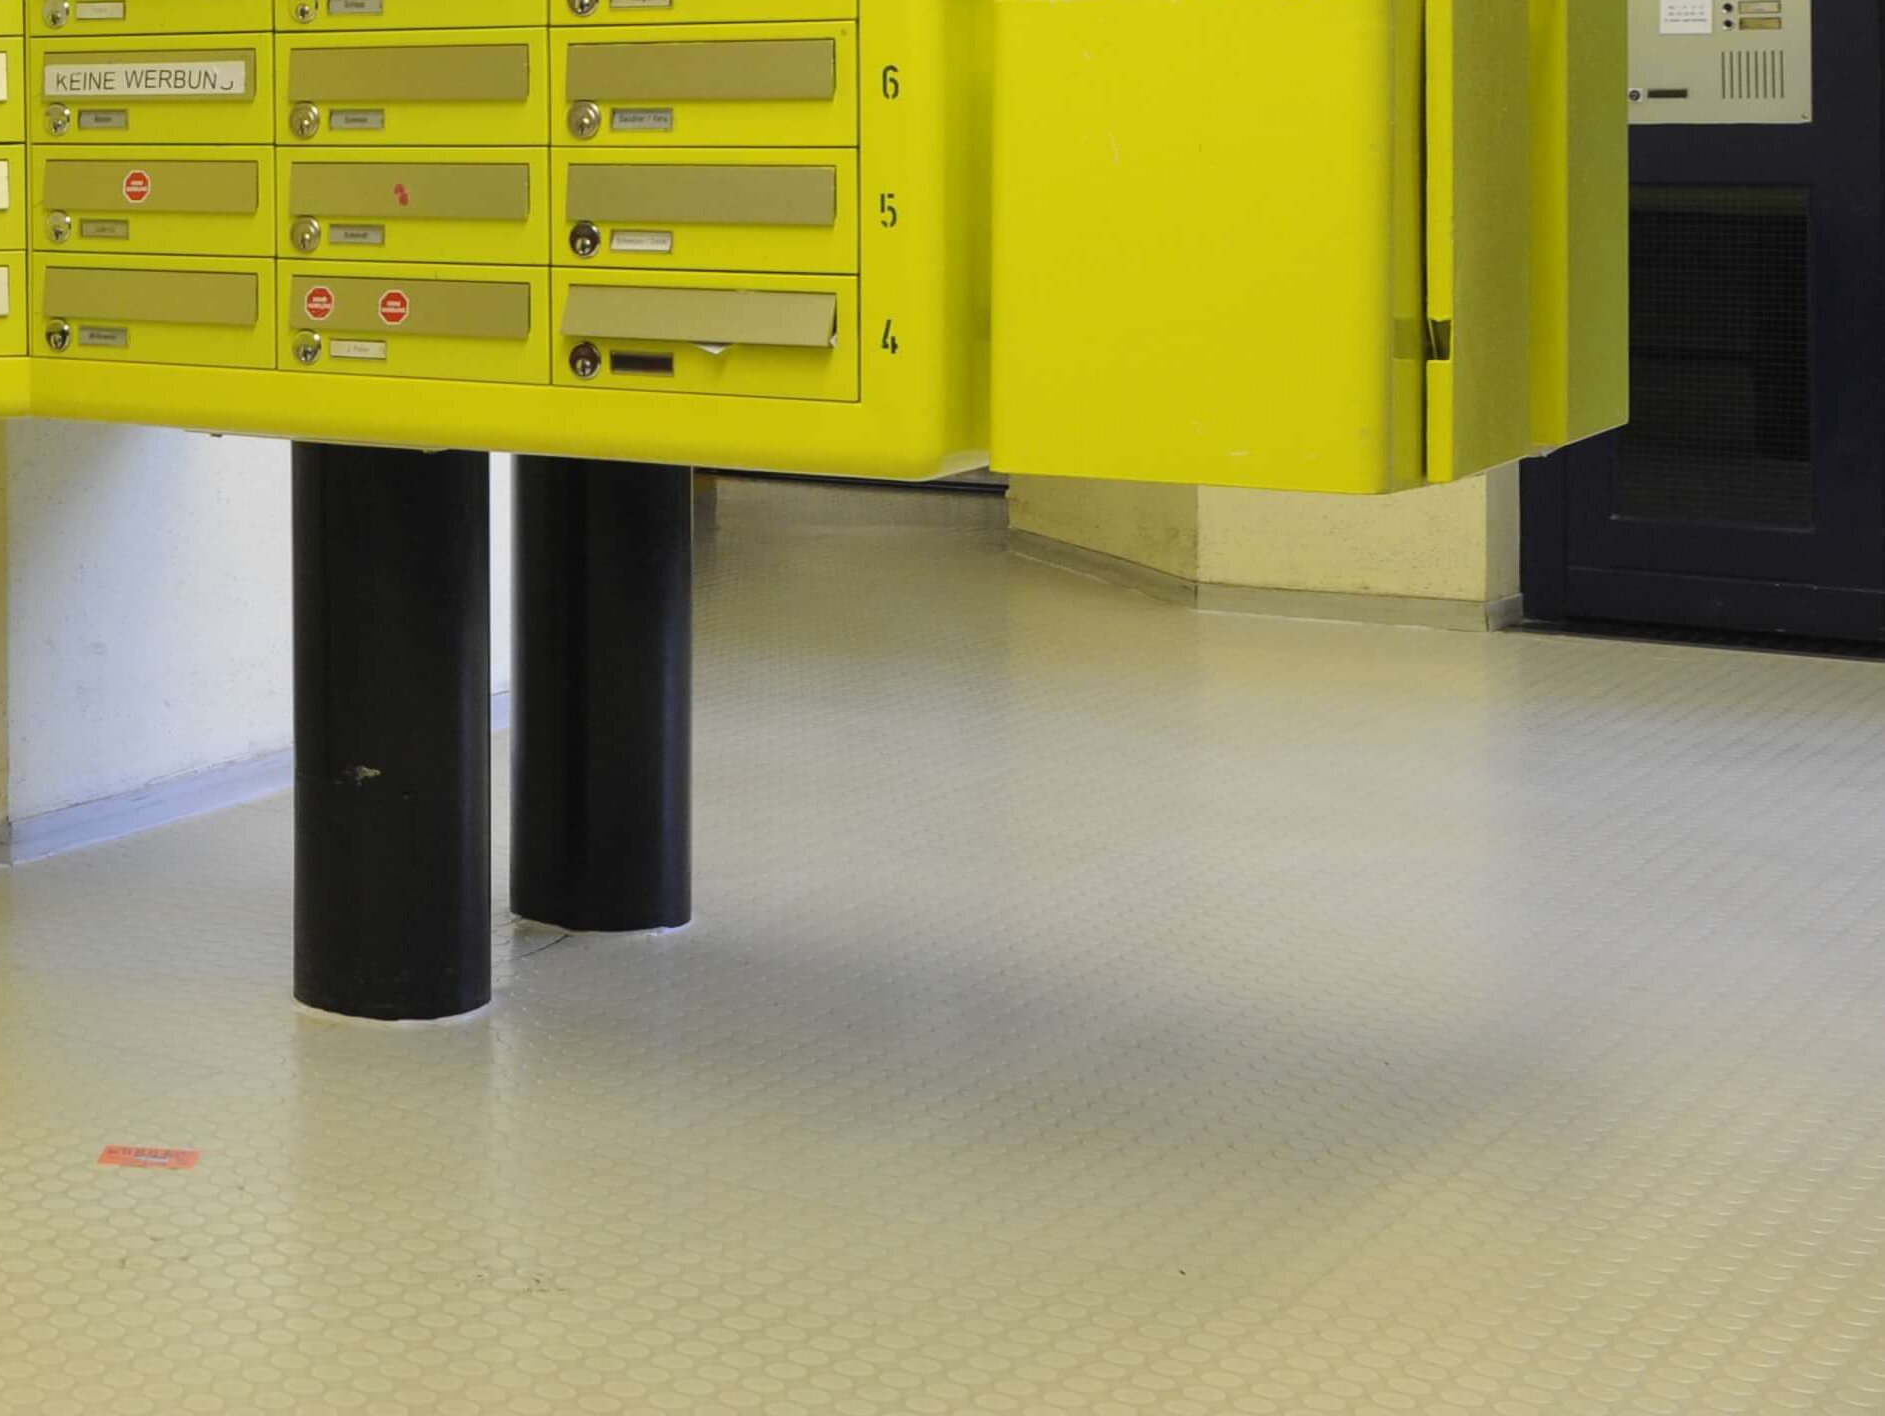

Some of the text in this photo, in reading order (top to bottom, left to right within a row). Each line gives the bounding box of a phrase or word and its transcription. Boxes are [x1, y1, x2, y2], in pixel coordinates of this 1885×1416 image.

[55, 70, 116, 91] KEINE
[882, 64, 899, 100] 6
[880, 192, 898, 229] 5
[881, 319, 898, 355] 4
